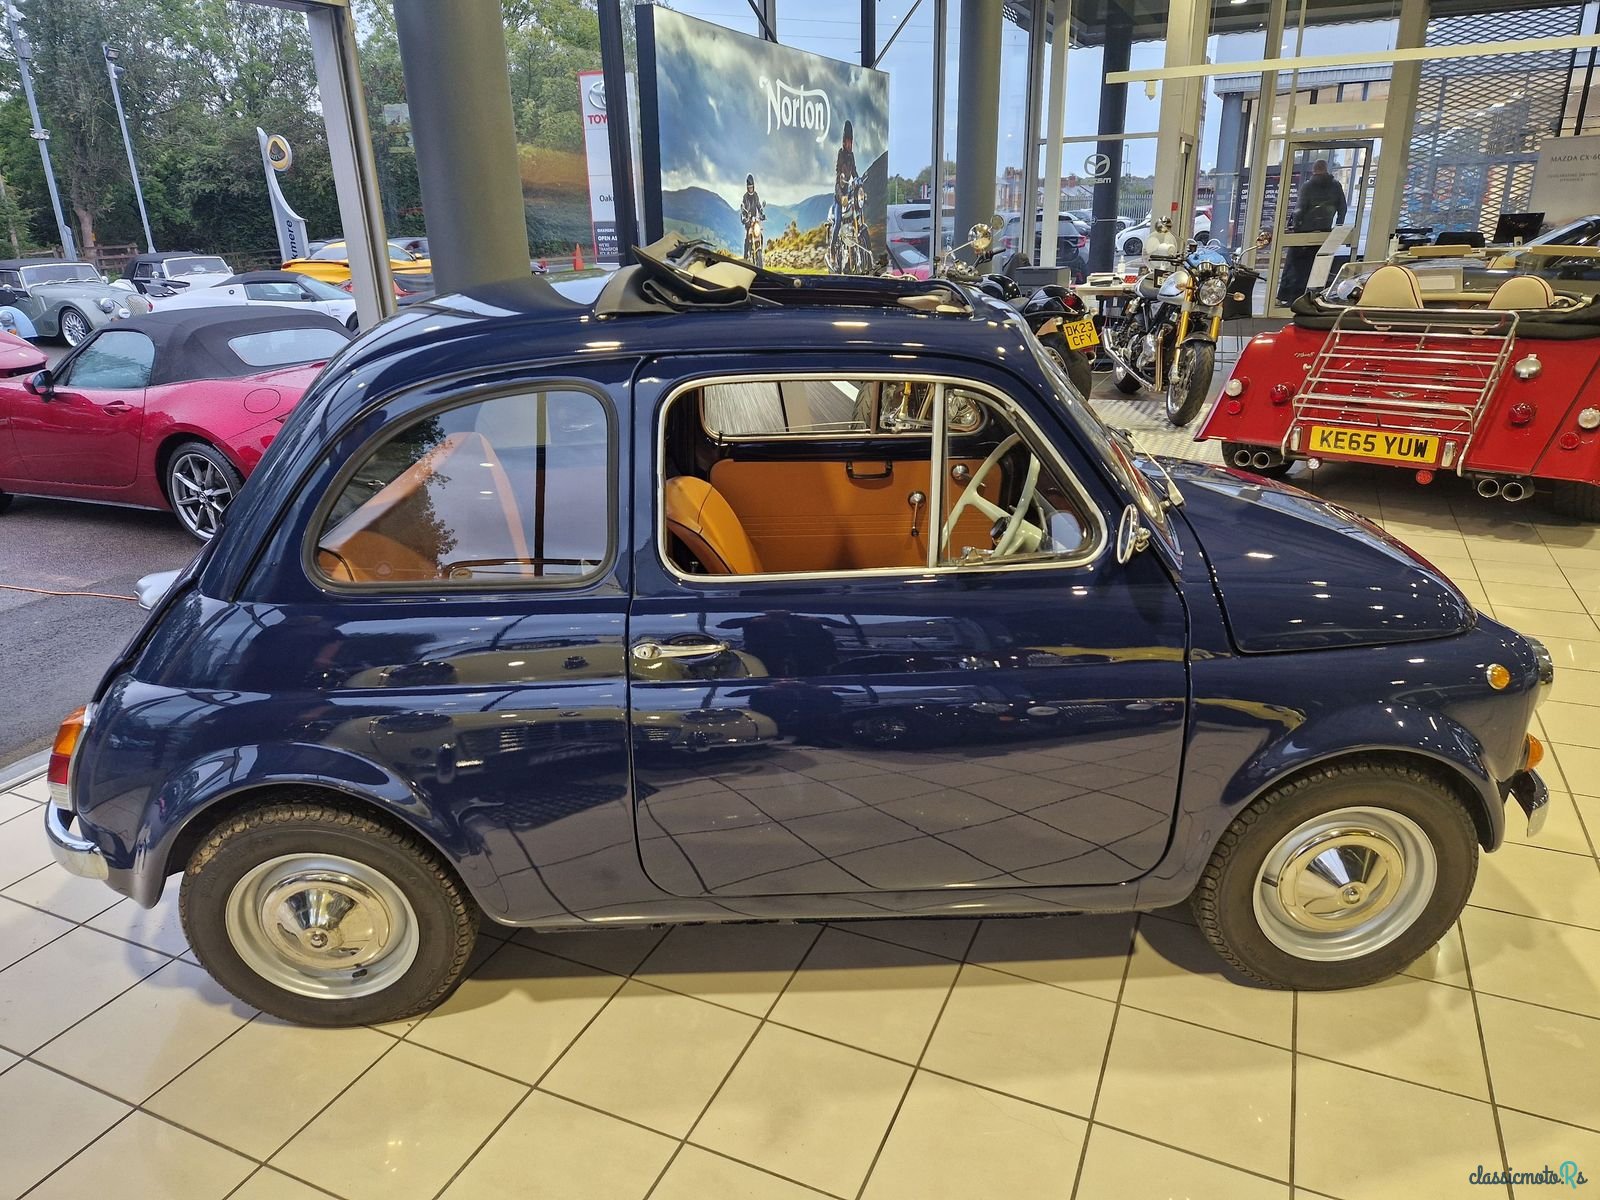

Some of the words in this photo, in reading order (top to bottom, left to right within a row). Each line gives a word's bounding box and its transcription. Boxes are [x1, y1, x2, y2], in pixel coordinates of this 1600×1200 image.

[758, 76, 831, 143] Norton
[587, 114, 608, 125] TOY
[599, 194, 613, 202] Oak
[287, 220, 298, 260] kmere
[1065, 321, 1094, 337] DK23
[1072, 333, 1093, 346] CFY
[1319, 430, 1377, 453] KE65
[1384, 436, 1429, 459] YUW
